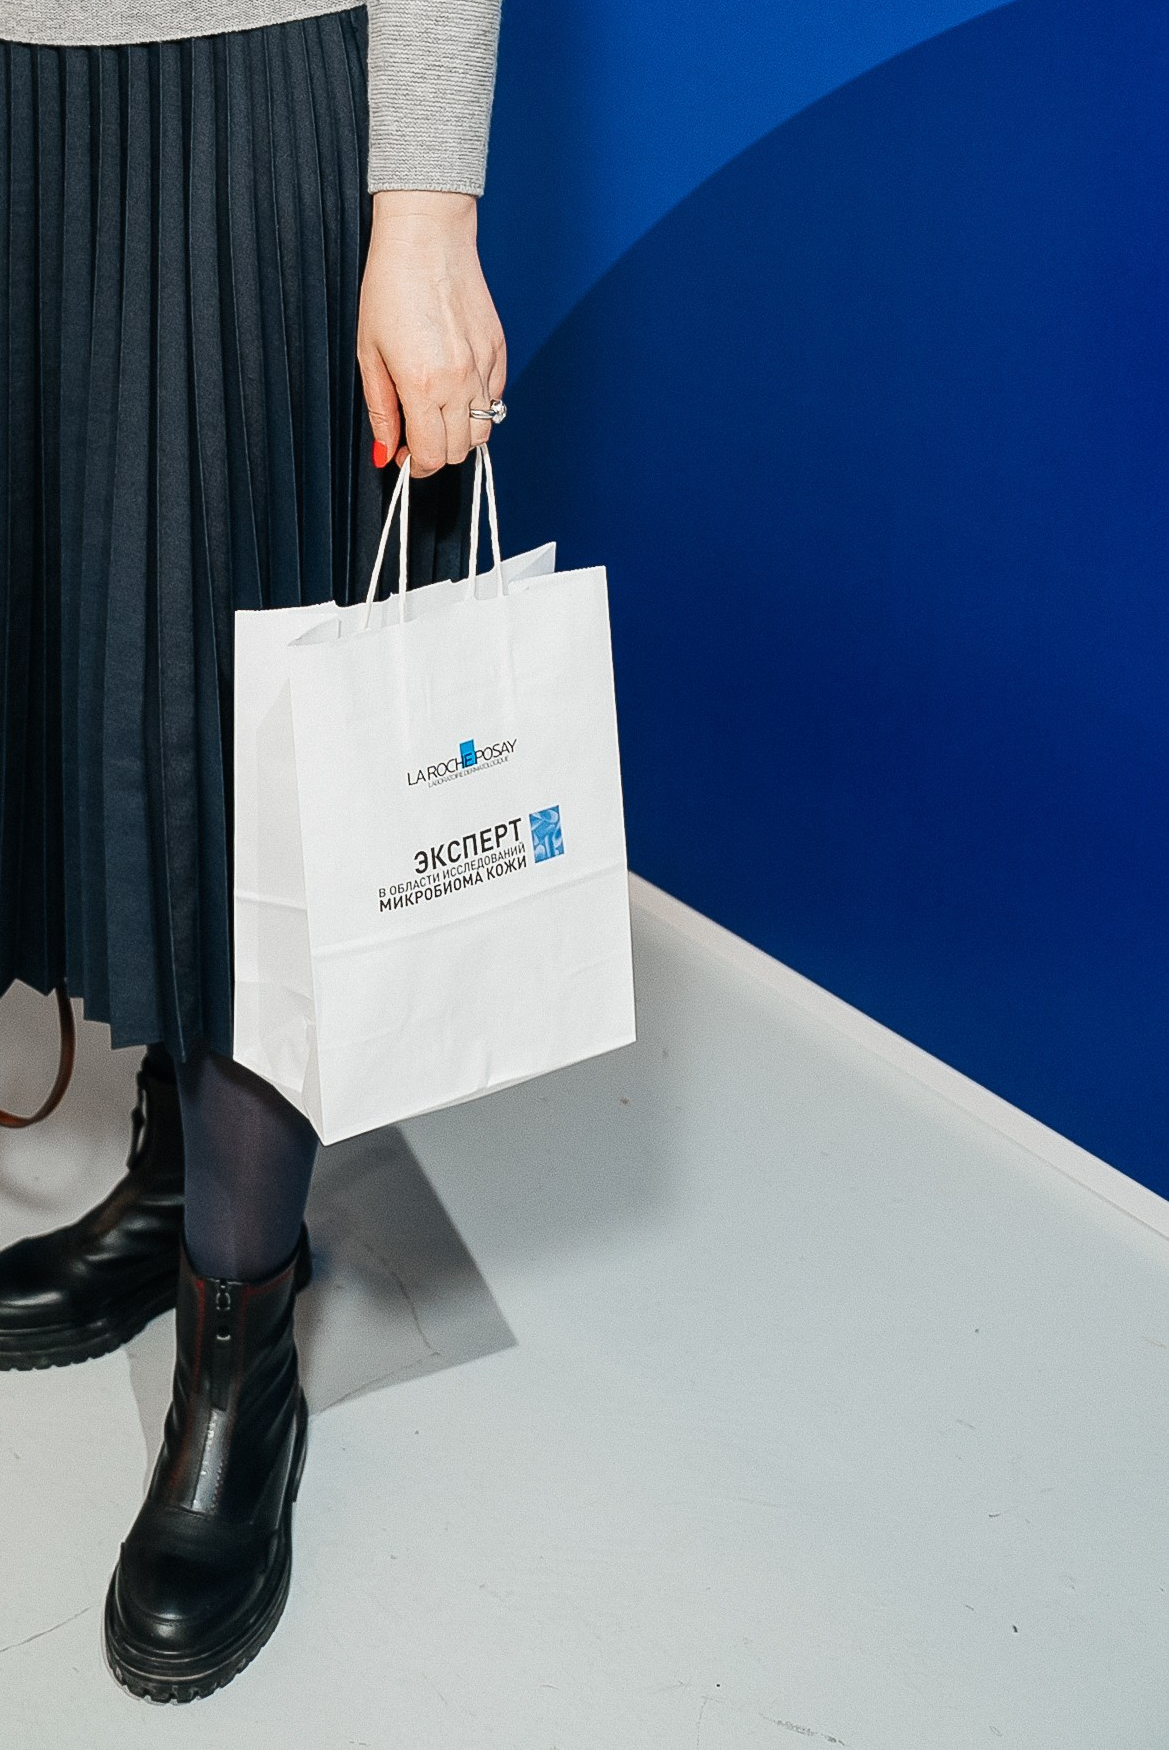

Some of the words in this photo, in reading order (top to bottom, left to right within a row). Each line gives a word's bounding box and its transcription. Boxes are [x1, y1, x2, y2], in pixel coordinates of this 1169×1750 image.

[407, 769, 427, 786] LA
[474, 738, 518, 765] POSAY
[378, 887, 387, 898] В
[389, 872, 441, 897] ОБЛАСТИ
[442, 842, 526, 879] ИССЛЕДОВАНИЙ
[413, 817, 523, 874] ЭКСПЕРТ
[378, 870, 484, 913] МИКРОБИОМА
[486, 855, 528, 880] КОЖИ
